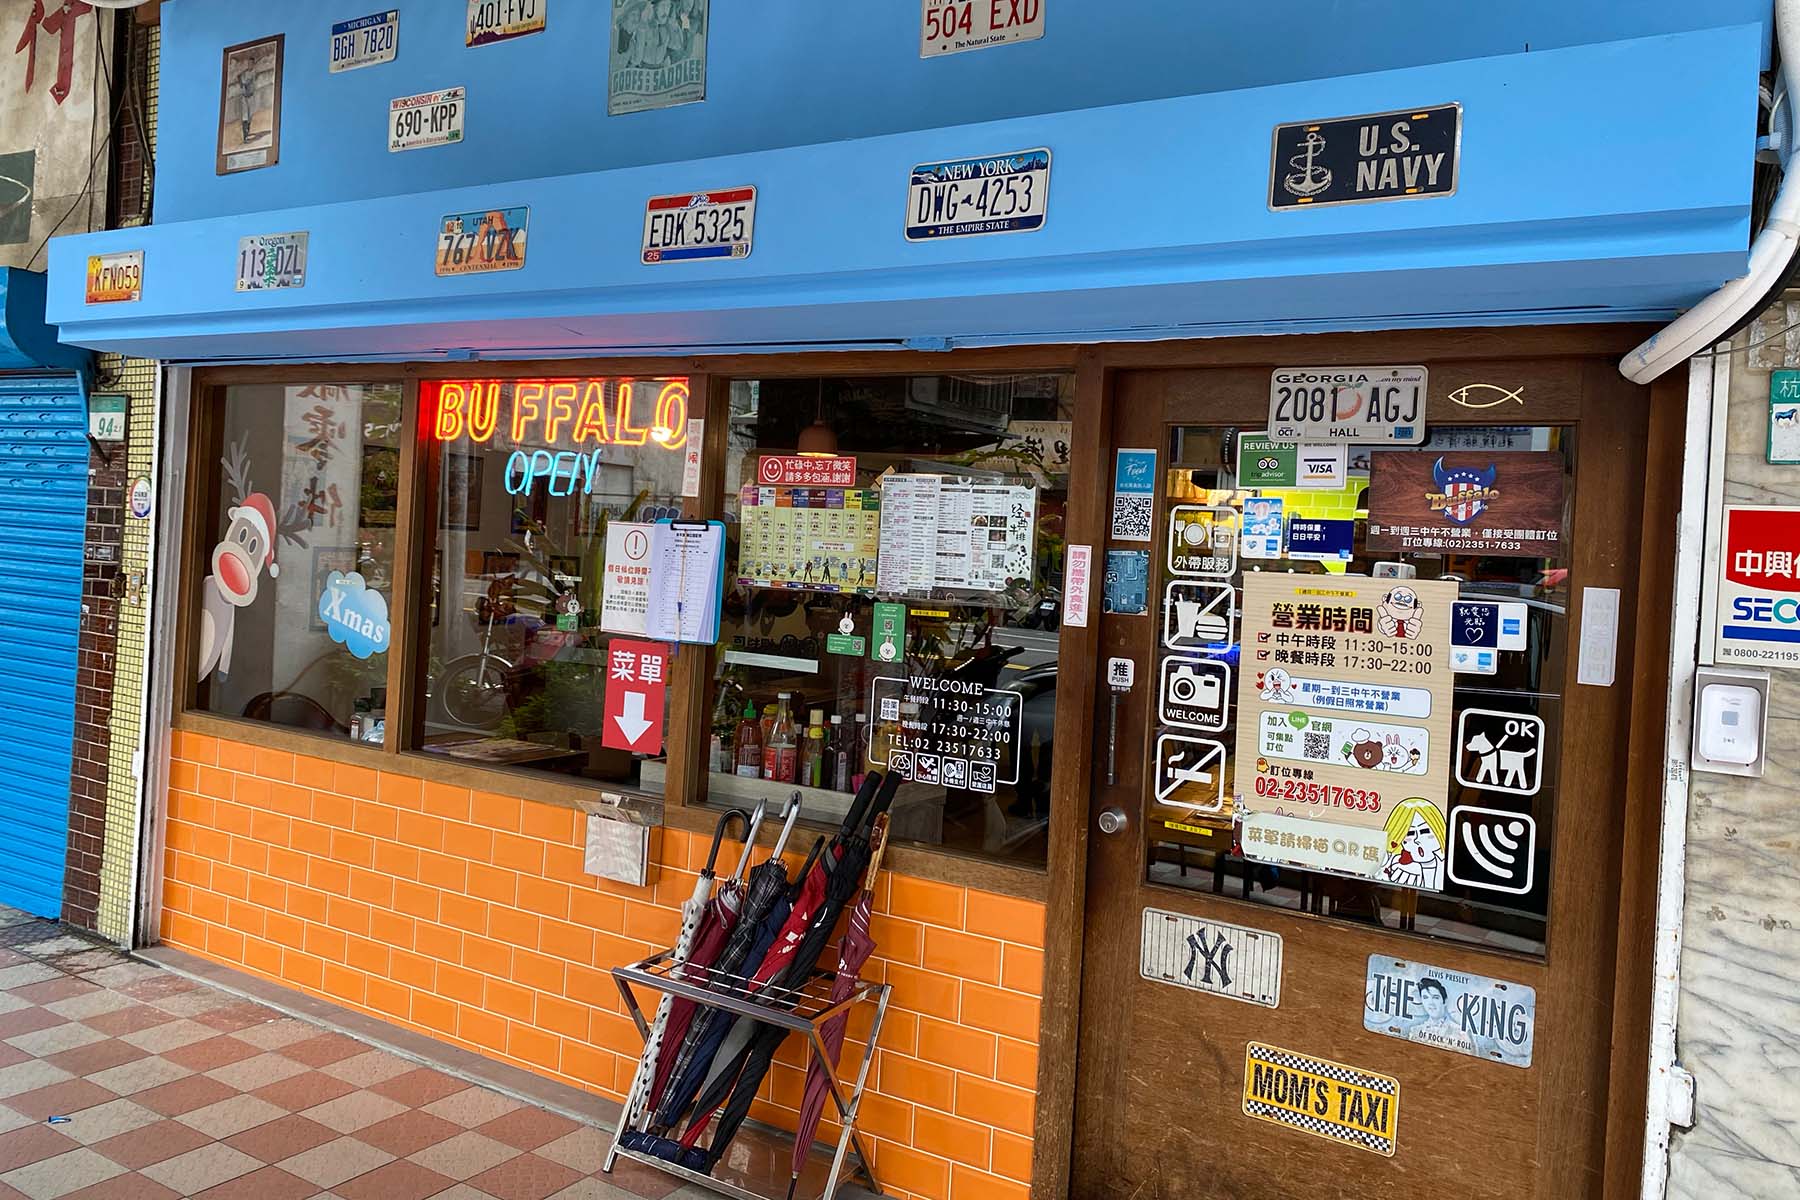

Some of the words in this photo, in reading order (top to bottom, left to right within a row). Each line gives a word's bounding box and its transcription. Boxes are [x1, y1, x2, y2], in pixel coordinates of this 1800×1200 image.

[347, 15, 383, 31] MICHIGAN
[926, 2, 973, 40] 504
[989, 0, 1039, 30] EXD
[333, 34, 356, 62] BGH
[363, 25, 394, 54] 7820
[955, 41, 966, 49] The
[966, 37, 989, 47] Natural
[990, 34, 1006, 43] State
[653, 58, 701, 93] SADDLES
[391, 94, 433, 109] WISCONSIN
[395, 103, 458, 138] 690-KPP
[1358, 121, 1420, 157] U.S.
[943, 164, 976, 182] NEW
[978, 157, 1016, 177] YORK
[1356, 152, 1445, 192] NAVY
[472, 215, 494, 227] UTAH
[649, 213, 687, 248] EDK
[693, 206, 747, 243] 5325
[938, 226, 954, 235] THE
[955, 222, 984, 233] EMPIRE
[985, 220, 1010, 230] STATE
[259, 236, 286, 249] Oregon
[442, 233, 475, 265] 767
[647, 251, 660, 261] 25
[1275, 373, 1369, 384] GEORGIA
[1275, 387, 1338, 423] 2081
[1366, 387, 1420, 423] AGJ
[98, 416, 114, 437] 94
[1278, 428, 1295, 437] OCT
[1329, 428, 1360, 437] HALL
[1243, 442, 1280, 450] REVIEW
[1282, 442, 1295, 450] US
[504, 448, 601, 496] OPEN
[1308, 464, 1333, 474] VISA
[1425, 486, 1500, 511] Buffalo
[1174, 555, 1230, 572] 外帶服務
[1735, 549, 1800, 579] 中興
[323, 587, 385, 644] Xmas
[1272, 602, 1374, 634] 營業時間
[1733, 597, 1800, 624] SEC
[1275, 632, 1337, 650] 中午時段
[1274, 649, 1336, 667] 晚餐時段
[1734, 648, 1799, 661] 0800-221195
[611, 650, 663, 685] 菜單
[1113, 661, 1129, 677] 推
[909, 675, 984, 696] WELCOME
[1111, 676, 1130, 684] PUSH
[1301, 682, 1401, 702] 星期一到三中午不營業
[934, 697, 1012, 717] 11:30-15:00
[1166, 708, 1220, 724] WELCOME
[932, 722, 1010, 743] 17:30-22:00
[1267, 715, 1288, 728] 加入
[1311, 720, 1333, 733] 官網
[1505, 720, 1536, 738] OK
[888, 734, 930, 750] TEL:02
[937, 741, 1001, 760] 23517633
[1266, 742, 1284, 752] 訂位
[1267, 731, 1294, 743] 可集點
[1270, 764, 1314, 780] 訂位專線
[1255, 775, 1382, 813] 02-23517633
[1428, 969, 1444, 979] ELVIS
[1445, 973, 1469, 985] PRESLEY
[1373, 973, 1415, 1020] THE
[1461, 992, 1527, 1045] KING
[1418, 1030, 1427, 1039] OF
[1427, 1034, 1444, 1044] ROCK
[1457, 1040, 1472, 1050] ROLL
[1252, 1063, 1330, 1116] MOM'S
[1337, 1085, 1389, 1133] TAXI
